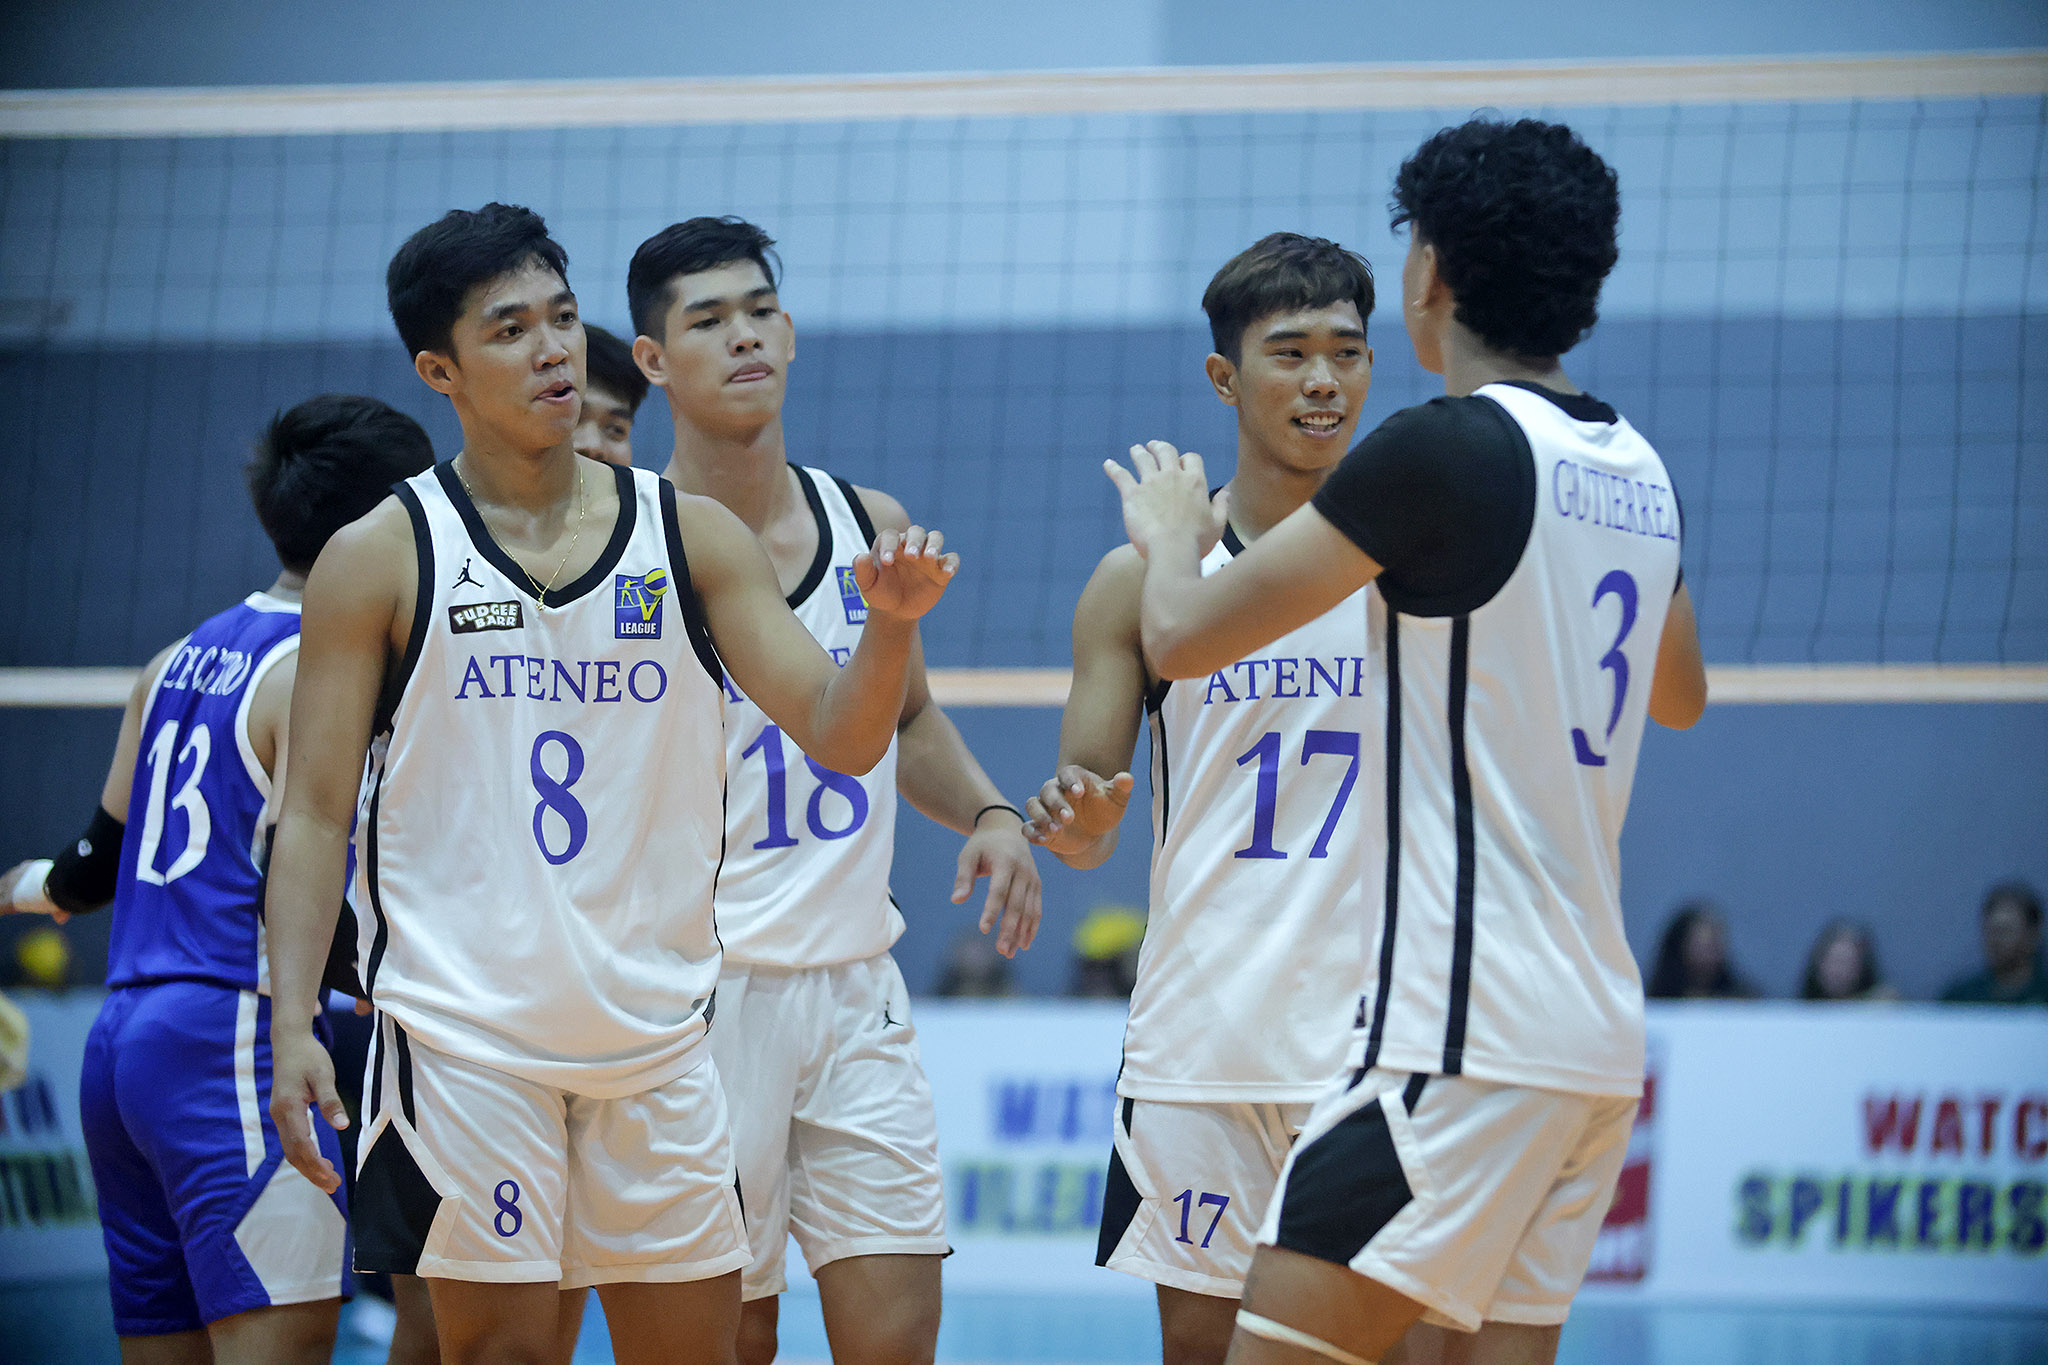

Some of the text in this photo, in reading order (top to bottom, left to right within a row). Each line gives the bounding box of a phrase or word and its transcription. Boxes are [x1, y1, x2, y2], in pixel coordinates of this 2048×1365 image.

[453, 604, 518, 627] FUDGEE
[474, 615, 516, 629] BARR
[620, 622, 657, 634] LEAGUE
[454, 654, 668, 703] ATENEO
[1571, 569, 1638, 767] 3
[136, 719, 211, 886] 13
[530, 730, 588, 865] 8
[741, 724, 869, 850] 18
[1234, 730, 1361, 859] 17
[494, 1180, 522, 1237] 8
[1172, 1188, 1231, 1248] 17
